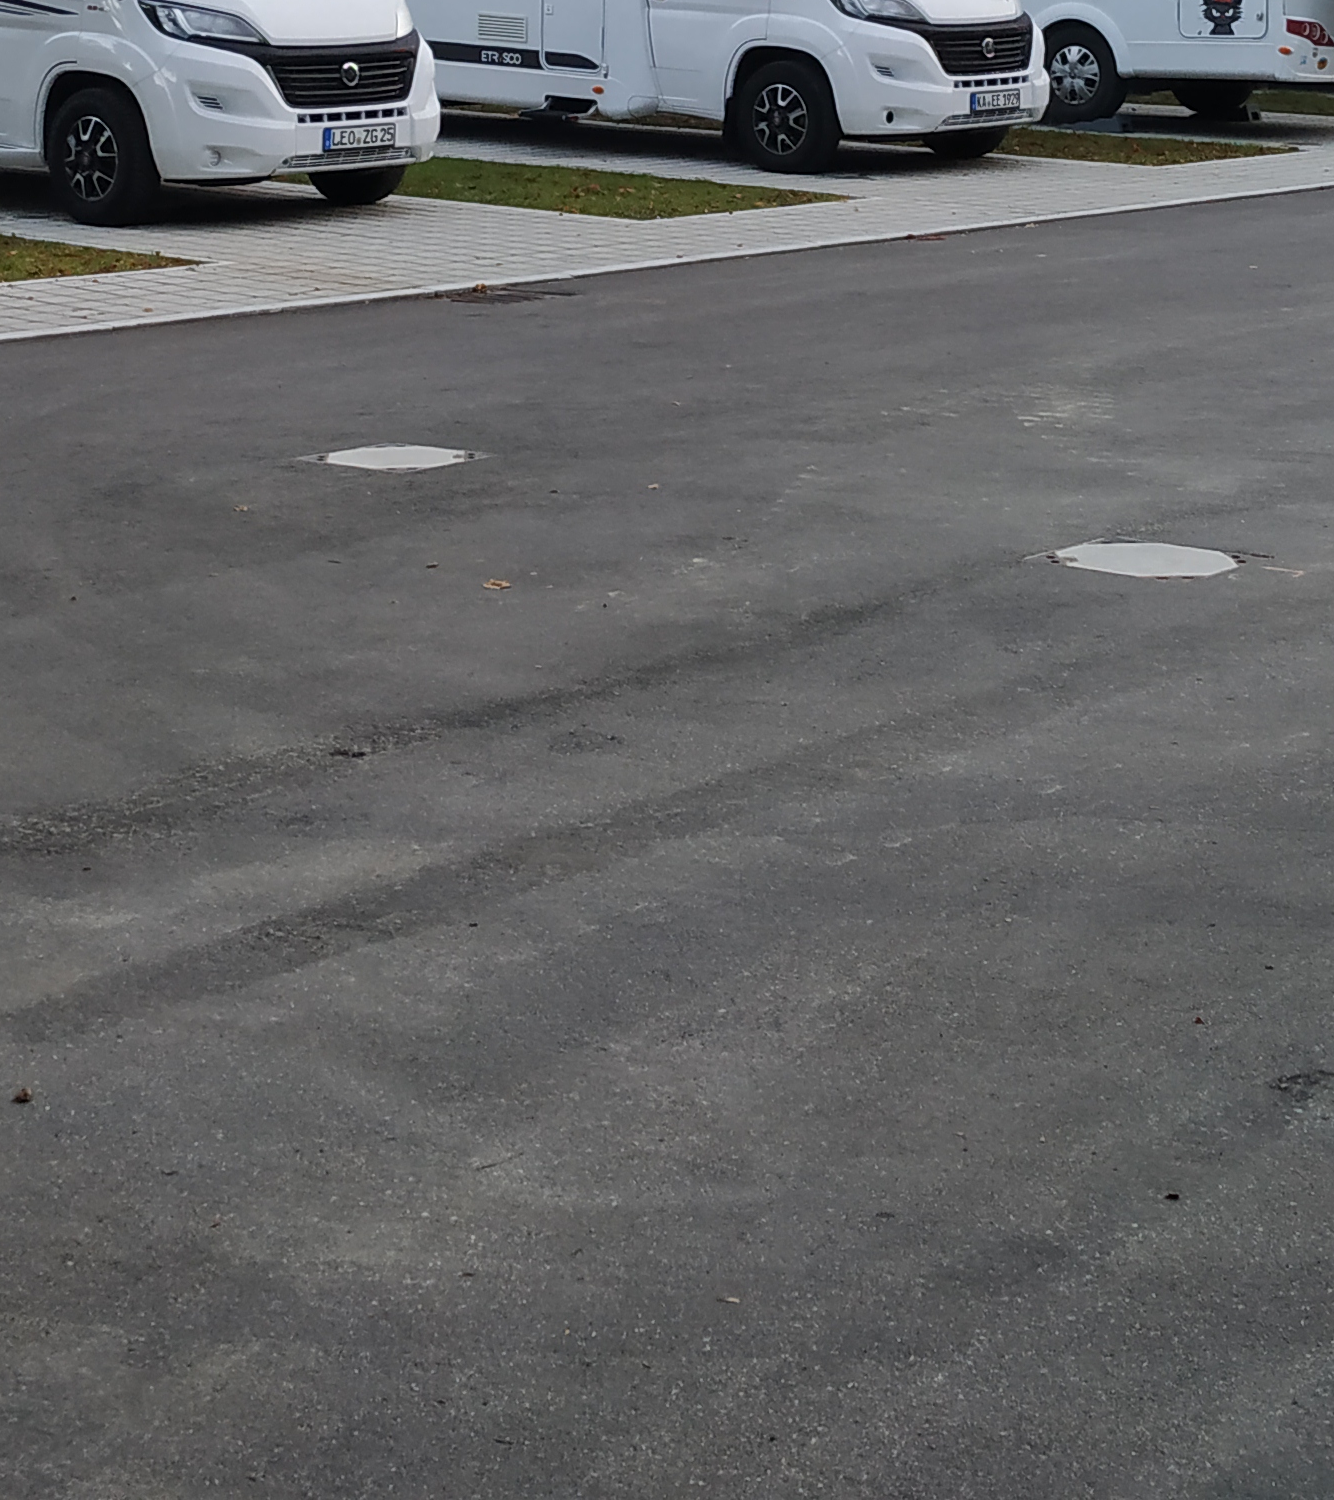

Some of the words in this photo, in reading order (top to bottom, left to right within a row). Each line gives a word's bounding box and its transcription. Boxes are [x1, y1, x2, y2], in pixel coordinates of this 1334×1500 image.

[977, 95, 987, 108] KA
[991, 93, 1001, 107] EE
[332, 130, 356, 147] LEO
[363, 128, 378, 145] ZG
[380, 126, 394, 143] 25
